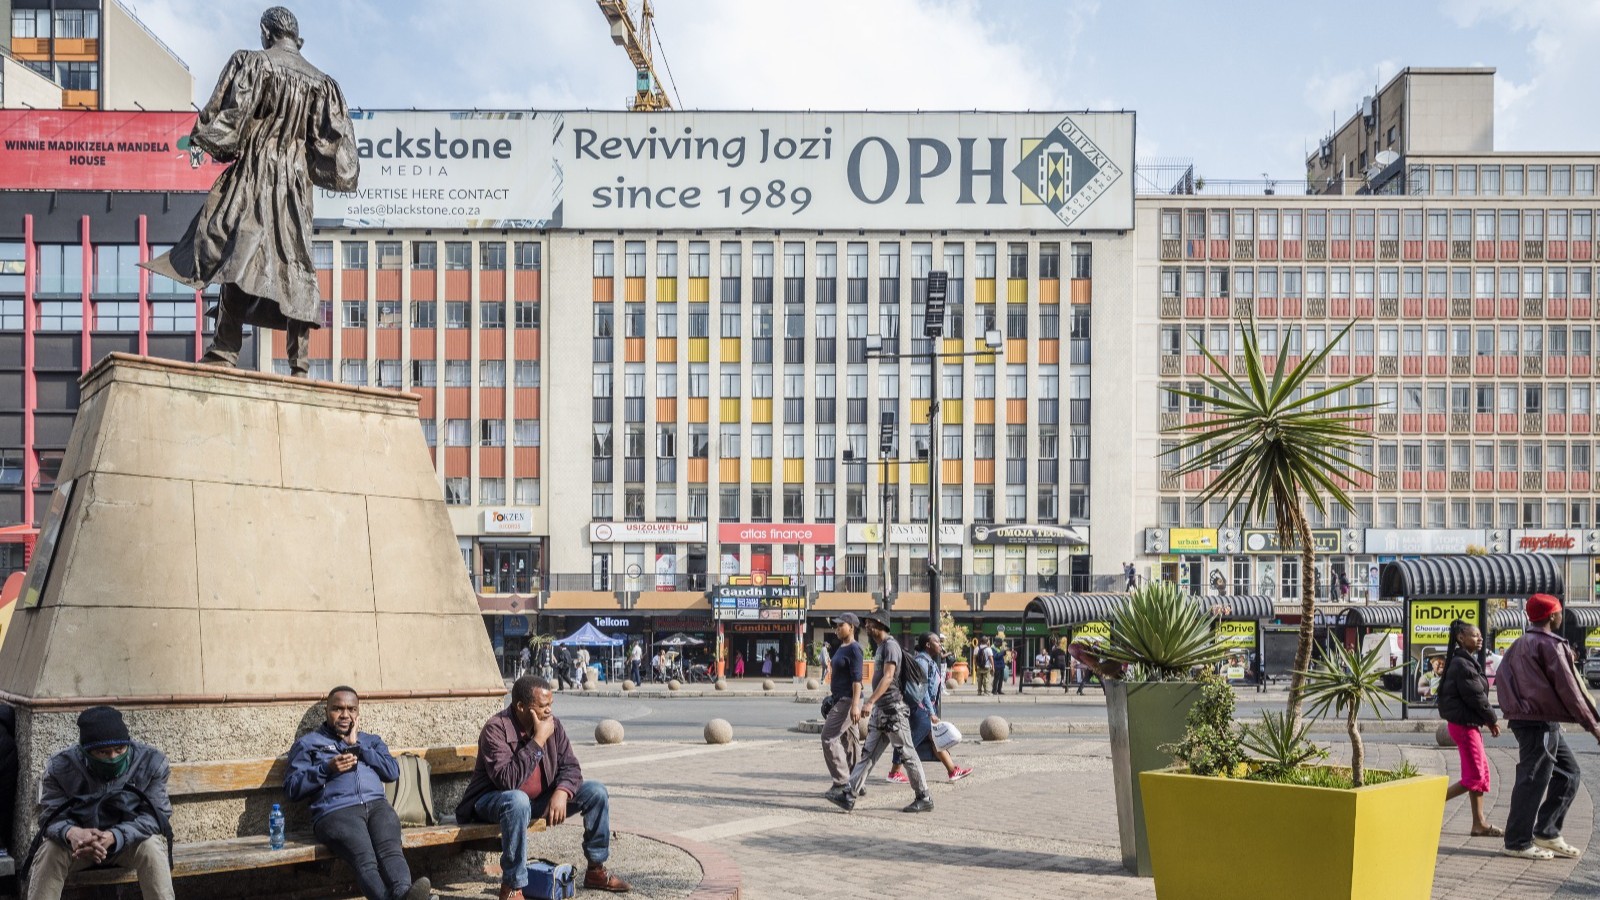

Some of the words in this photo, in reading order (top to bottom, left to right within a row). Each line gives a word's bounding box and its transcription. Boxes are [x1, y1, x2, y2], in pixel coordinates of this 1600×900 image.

[5, 140, 46, 150] WINNIE
[48, 141, 115, 152] MADIKIZELA
[117, 142, 170, 152] MANDELA
[357, 127, 512, 159] ackstone
[573, 127, 746, 168] Reviving
[760, 127, 833, 164] Jozi
[1061, 122, 1108, 169] OLITZKI
[69, 156, 106, 166] HOUSE
[381, 165, 448, 176] MEDIA
[847, 136, 1008, 205] OPH
[319, 188, 336, 199] TO
[340, 188, 408, 199] ADVERTISE
[412, 188, 445, 200] HERE
[449, 188, 509, 200] CONTACT
[592, 176, 701, 209] since
[717, 179, 812, 215] 1989
[347, 204, 481, 216] sales@blackstone.co.za
[740, 528, 767, 539] atlas
[770, 528, 813, 539] finance
[919, 526, 957, 535] MNEY
[996, 529, 1034, 538] UMOJA
[1036, 530, 1065, 538] TECH
[1520, 533, 1576, 552] myclinic
[720, 587, 767, 597] Gandhi
[772, 588, 799, 597] Mall
[1415, 605, 1476, 619] inDrive
[594, 617, 629, 627] Telkom
[734, 623, 771, 632] Gandhi
[1218, 624, 1254, 633] nDrive
